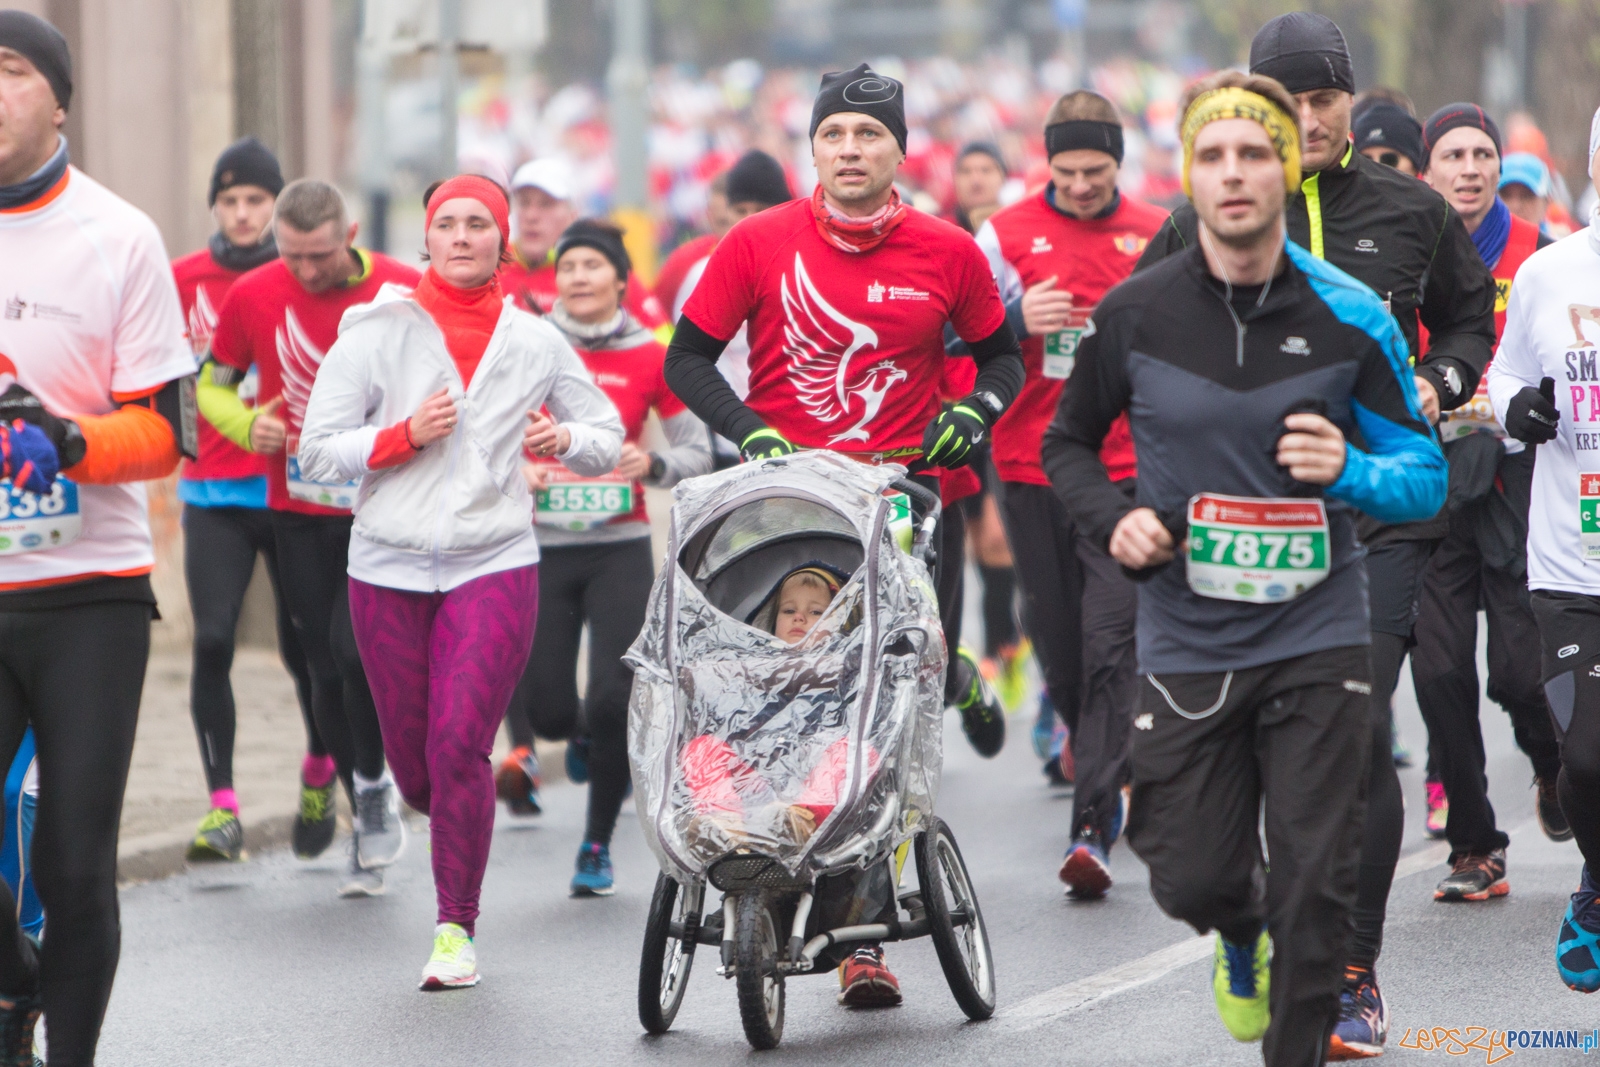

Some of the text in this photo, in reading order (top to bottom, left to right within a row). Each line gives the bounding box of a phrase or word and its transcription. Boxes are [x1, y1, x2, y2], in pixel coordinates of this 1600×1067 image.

[1575, 432, 1600, 450] KRE
[547, 487, 622, 512] 5536
[1206, 528, 1315, 569] 7875
